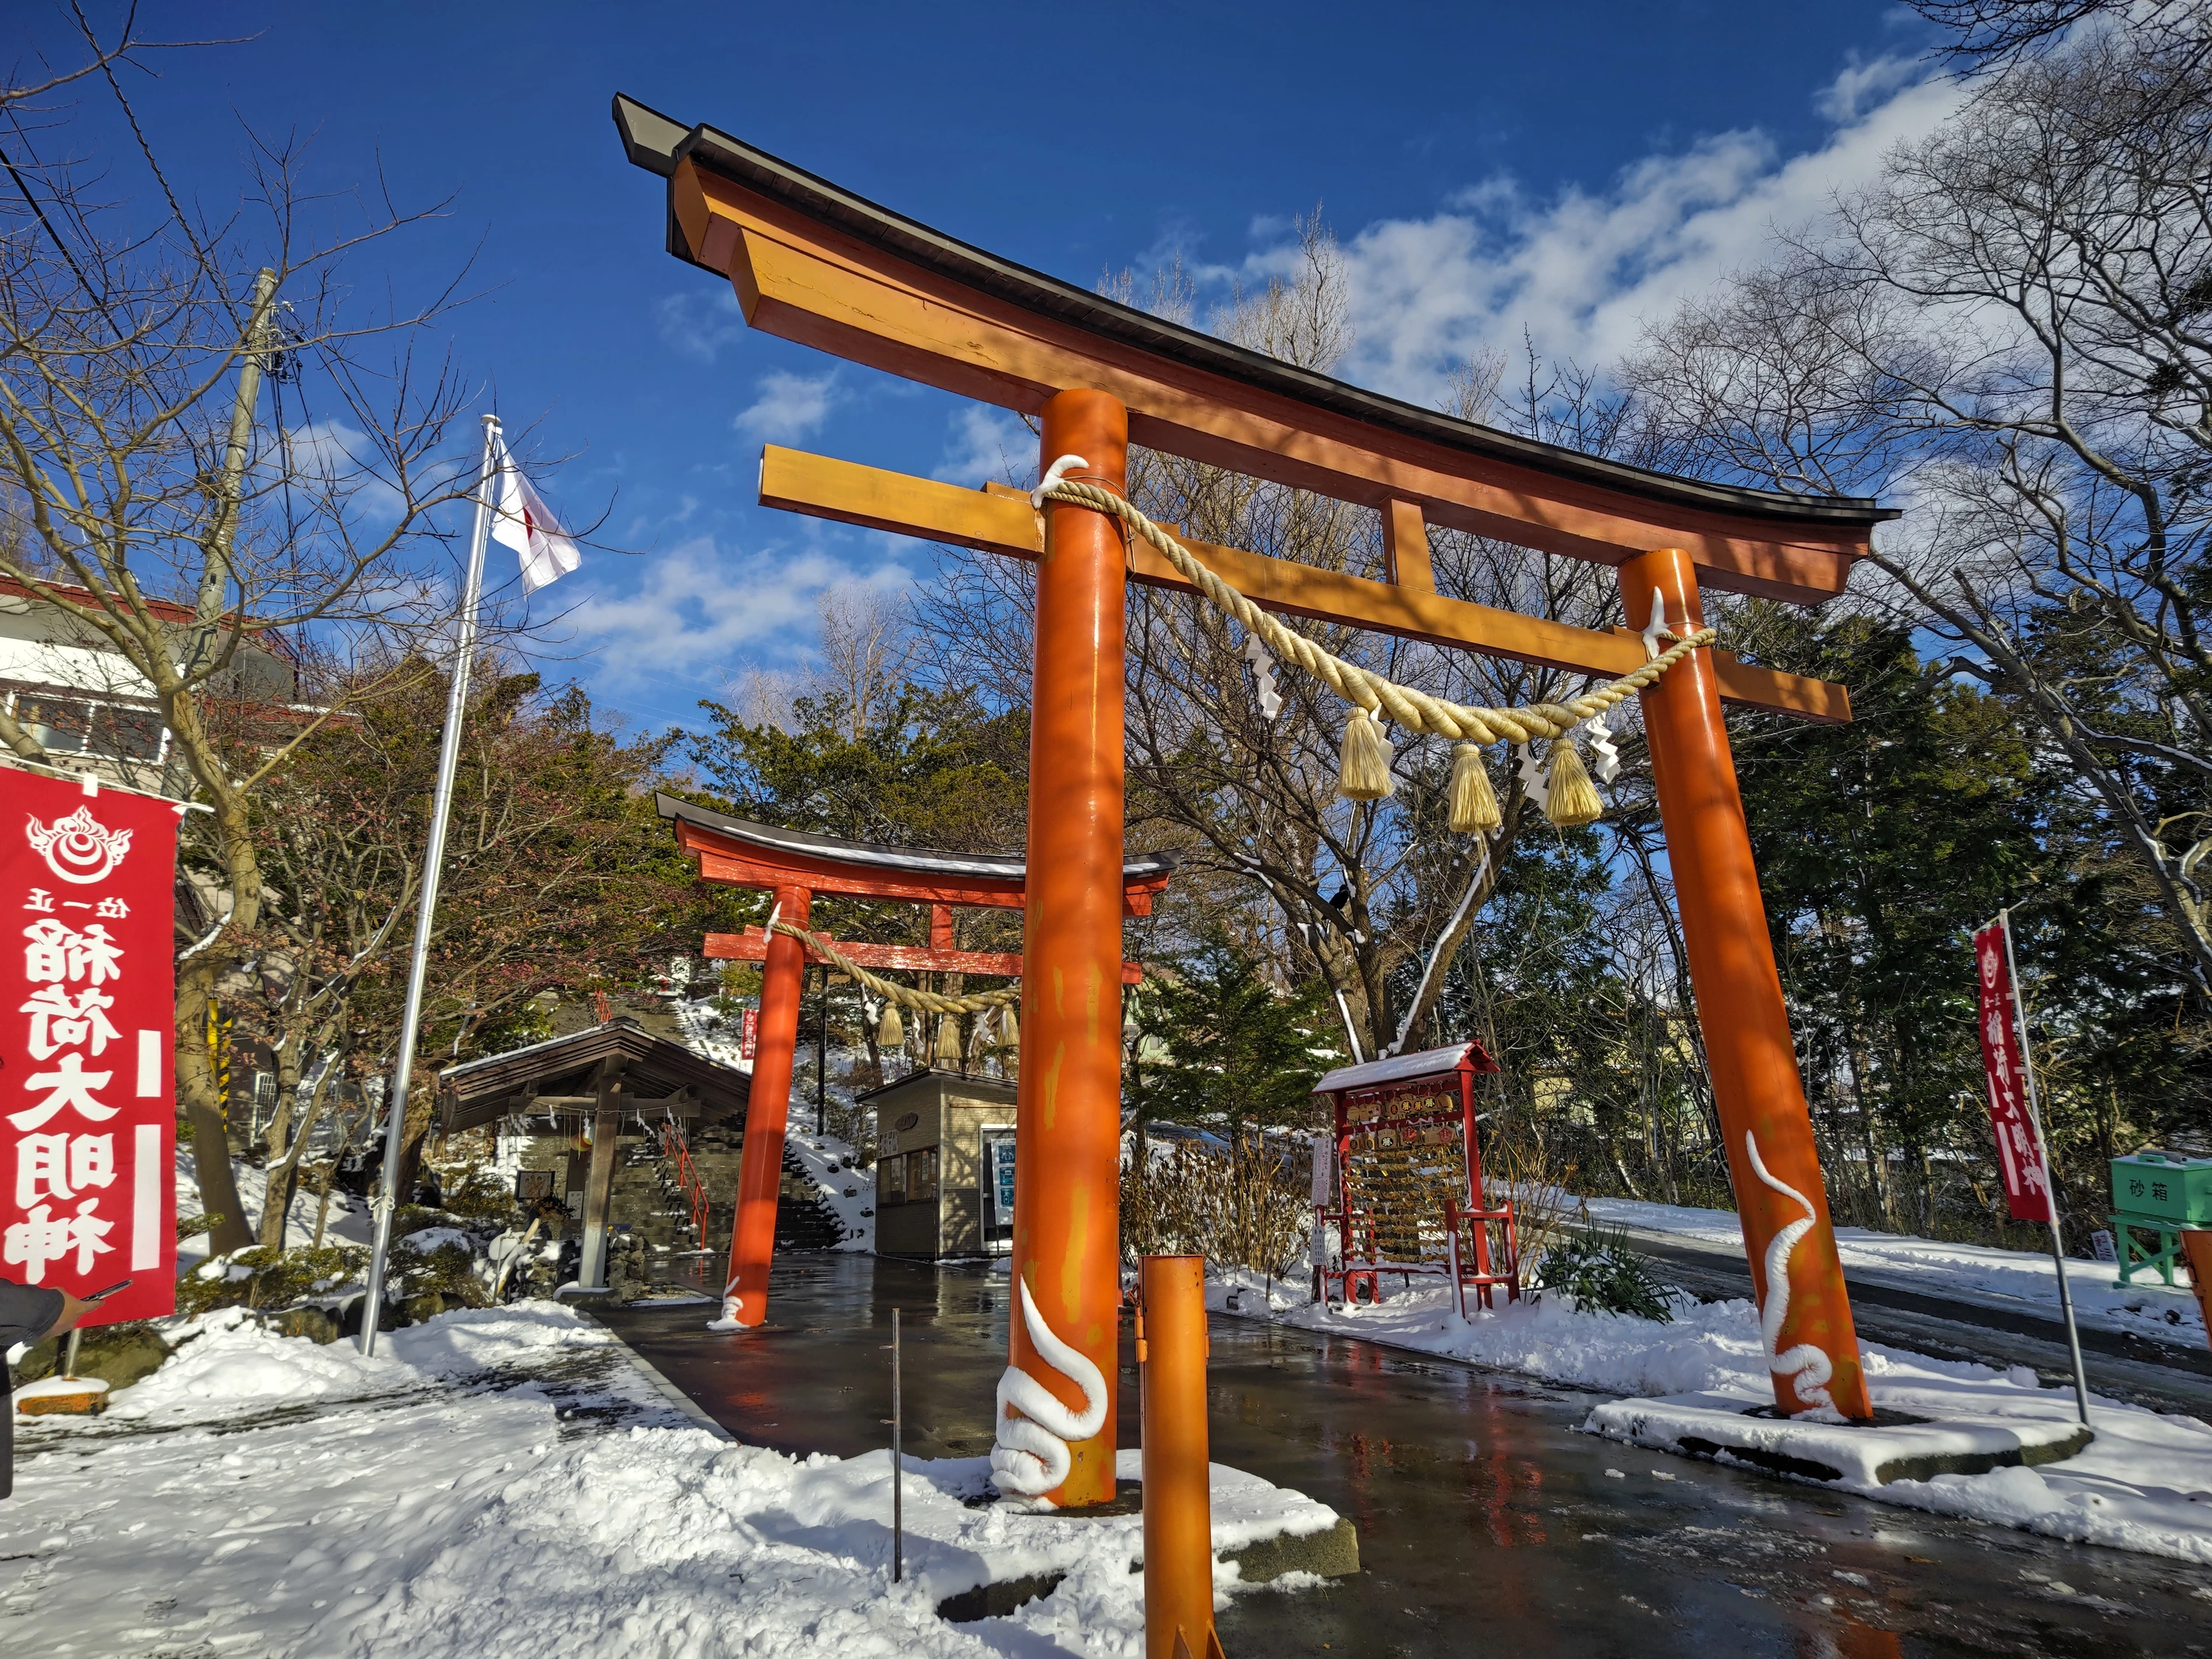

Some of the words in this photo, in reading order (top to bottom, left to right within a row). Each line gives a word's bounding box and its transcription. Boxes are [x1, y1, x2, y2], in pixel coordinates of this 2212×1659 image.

[1986, 1009, 2048, 1197] 稲荷大明神
[2129, 1179, 2168, 1201] 砂箱
